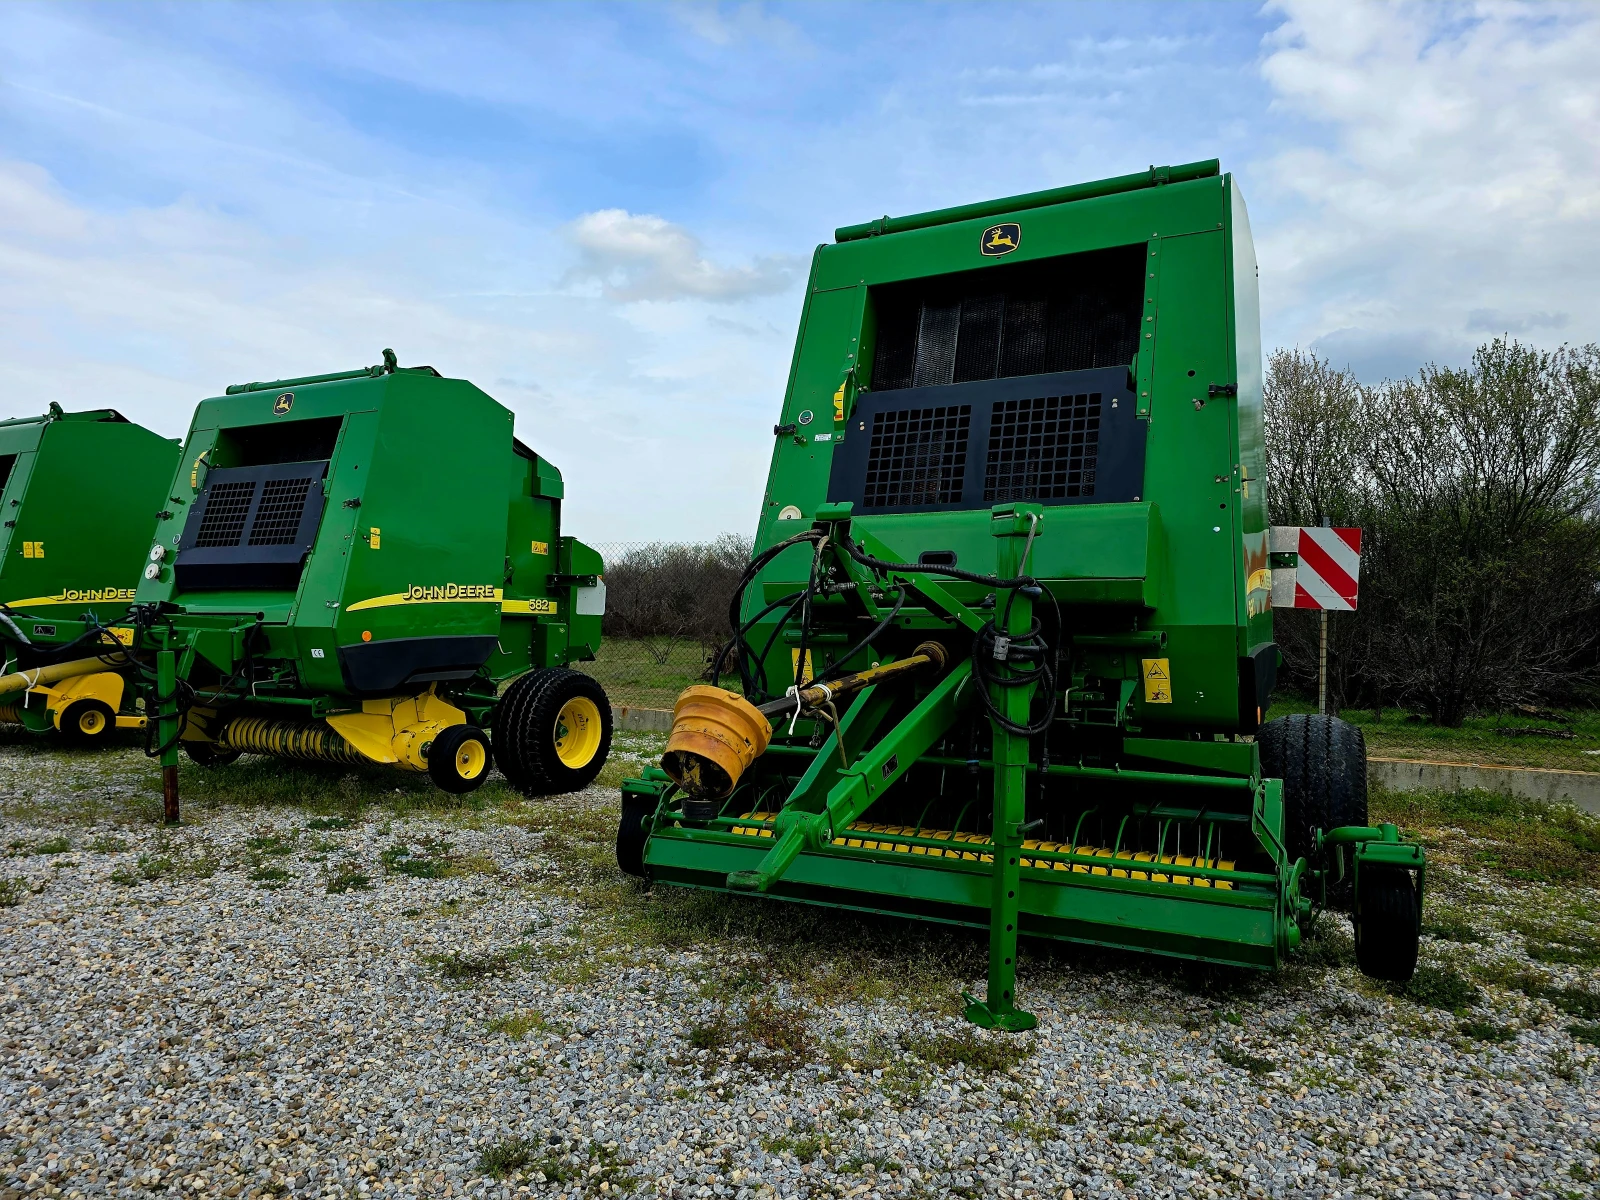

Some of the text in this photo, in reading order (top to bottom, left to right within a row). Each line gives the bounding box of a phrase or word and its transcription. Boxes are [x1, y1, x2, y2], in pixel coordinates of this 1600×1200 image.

[55, 587, 137, 601] JOHN DEE
[402, 583, 495, 600] JOHN DEERE
[528, 599, 550, 612] 582
